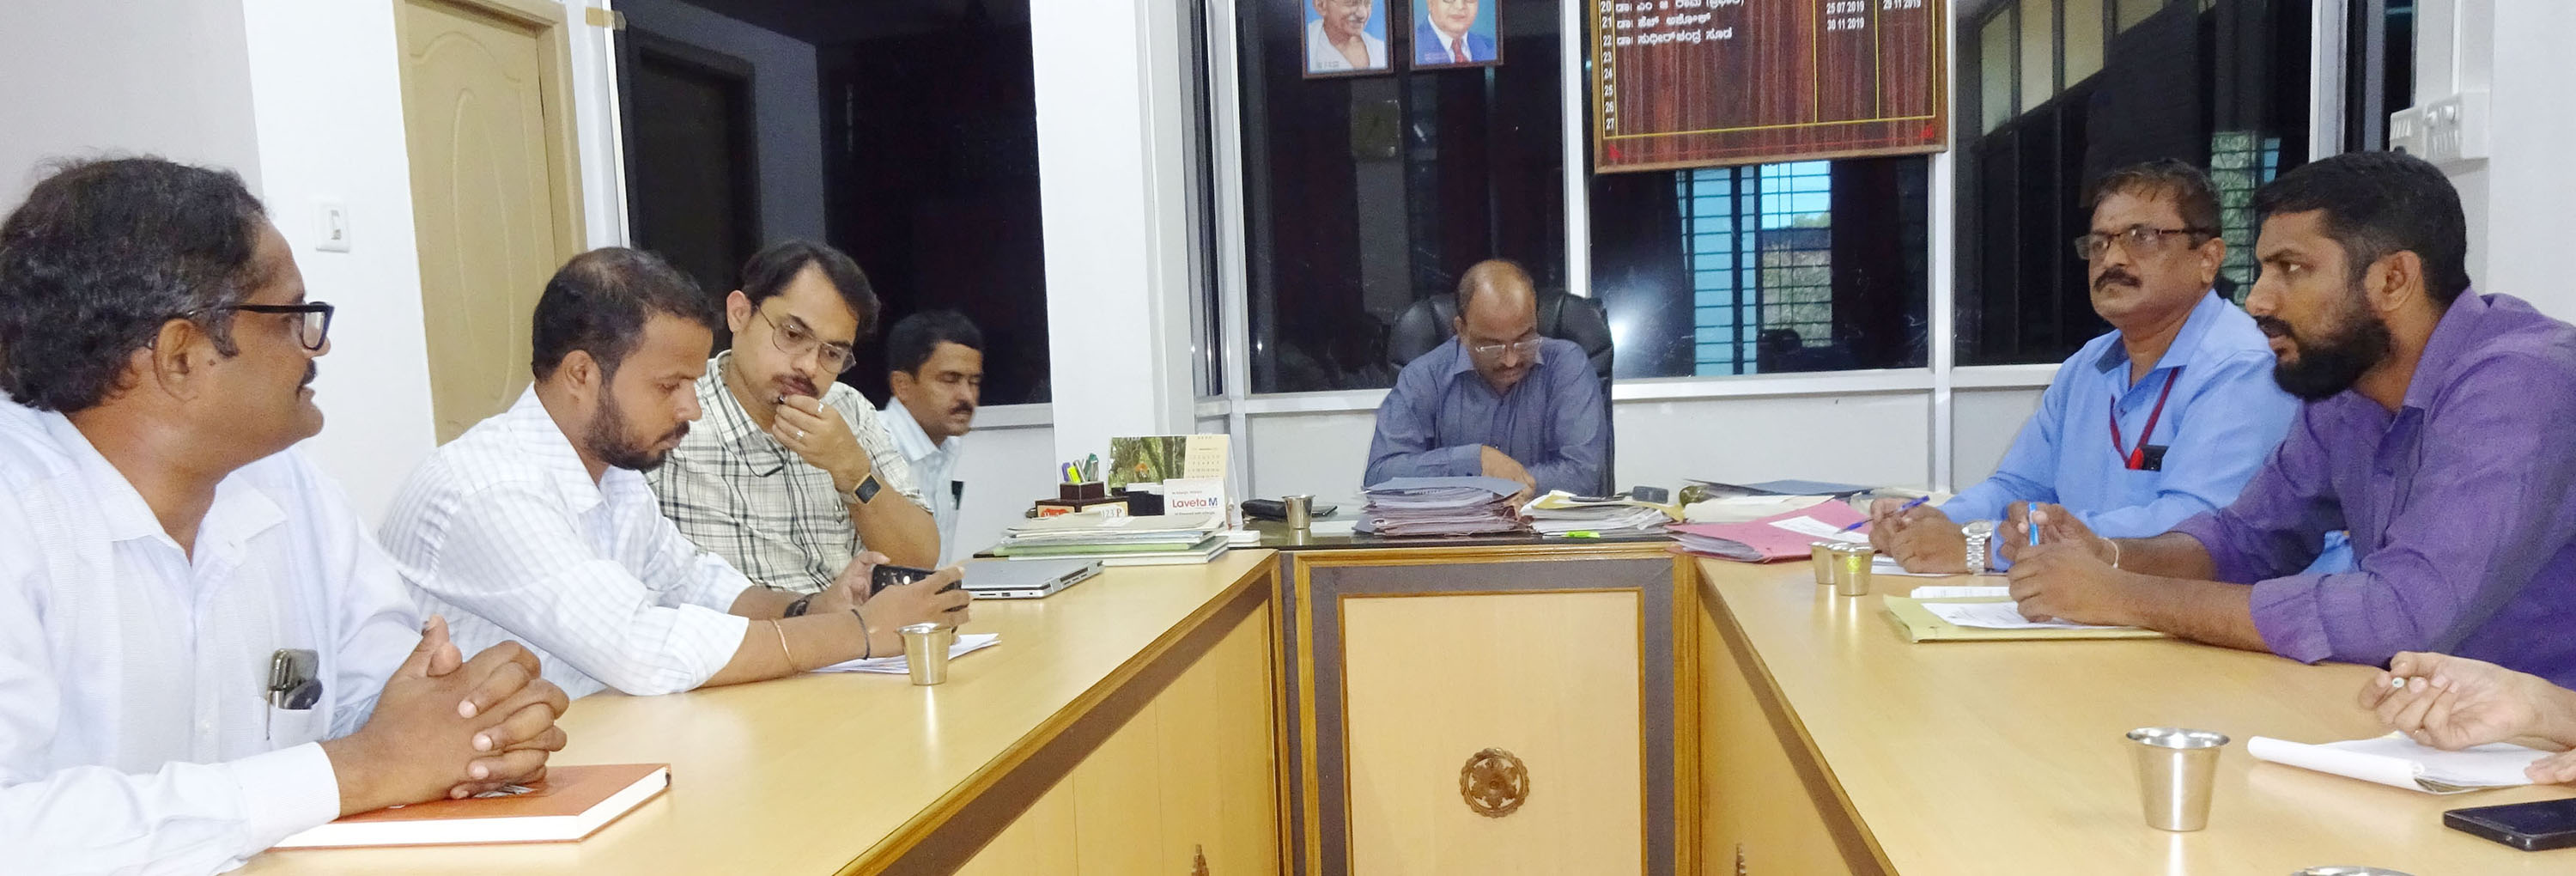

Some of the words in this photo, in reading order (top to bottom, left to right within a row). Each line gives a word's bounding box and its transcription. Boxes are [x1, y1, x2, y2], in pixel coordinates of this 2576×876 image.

[1601, 1, 1612, 13] 20
[1826, 3, 1836, 15] 25
[1837, 2, 1845, 14] 07
[1846, 0, 1864, 13] 2019
[1894, 0, 1902, 9] 11
[1903, 0, 1921, 9] 2019
[1601, 15, 1612, 27] 21
[1827, 19, 1836, 31] 30
[1838, 18, 1845, 30] 11
[1847, 17, 1864, 29] 2019
[1602, 34, 1612, 46] 22
[1602, 51, 1612, 64] 23
[1603, 67, 1613, 80] 24
[1604, 84, 1613, 97] 25
[1605, 100, 1614, 113] 26
[1606, 118, 1614, 130] 27
[1172, 498, 1207, 508] Laveta
[1208, 497, 1218, 507] M
